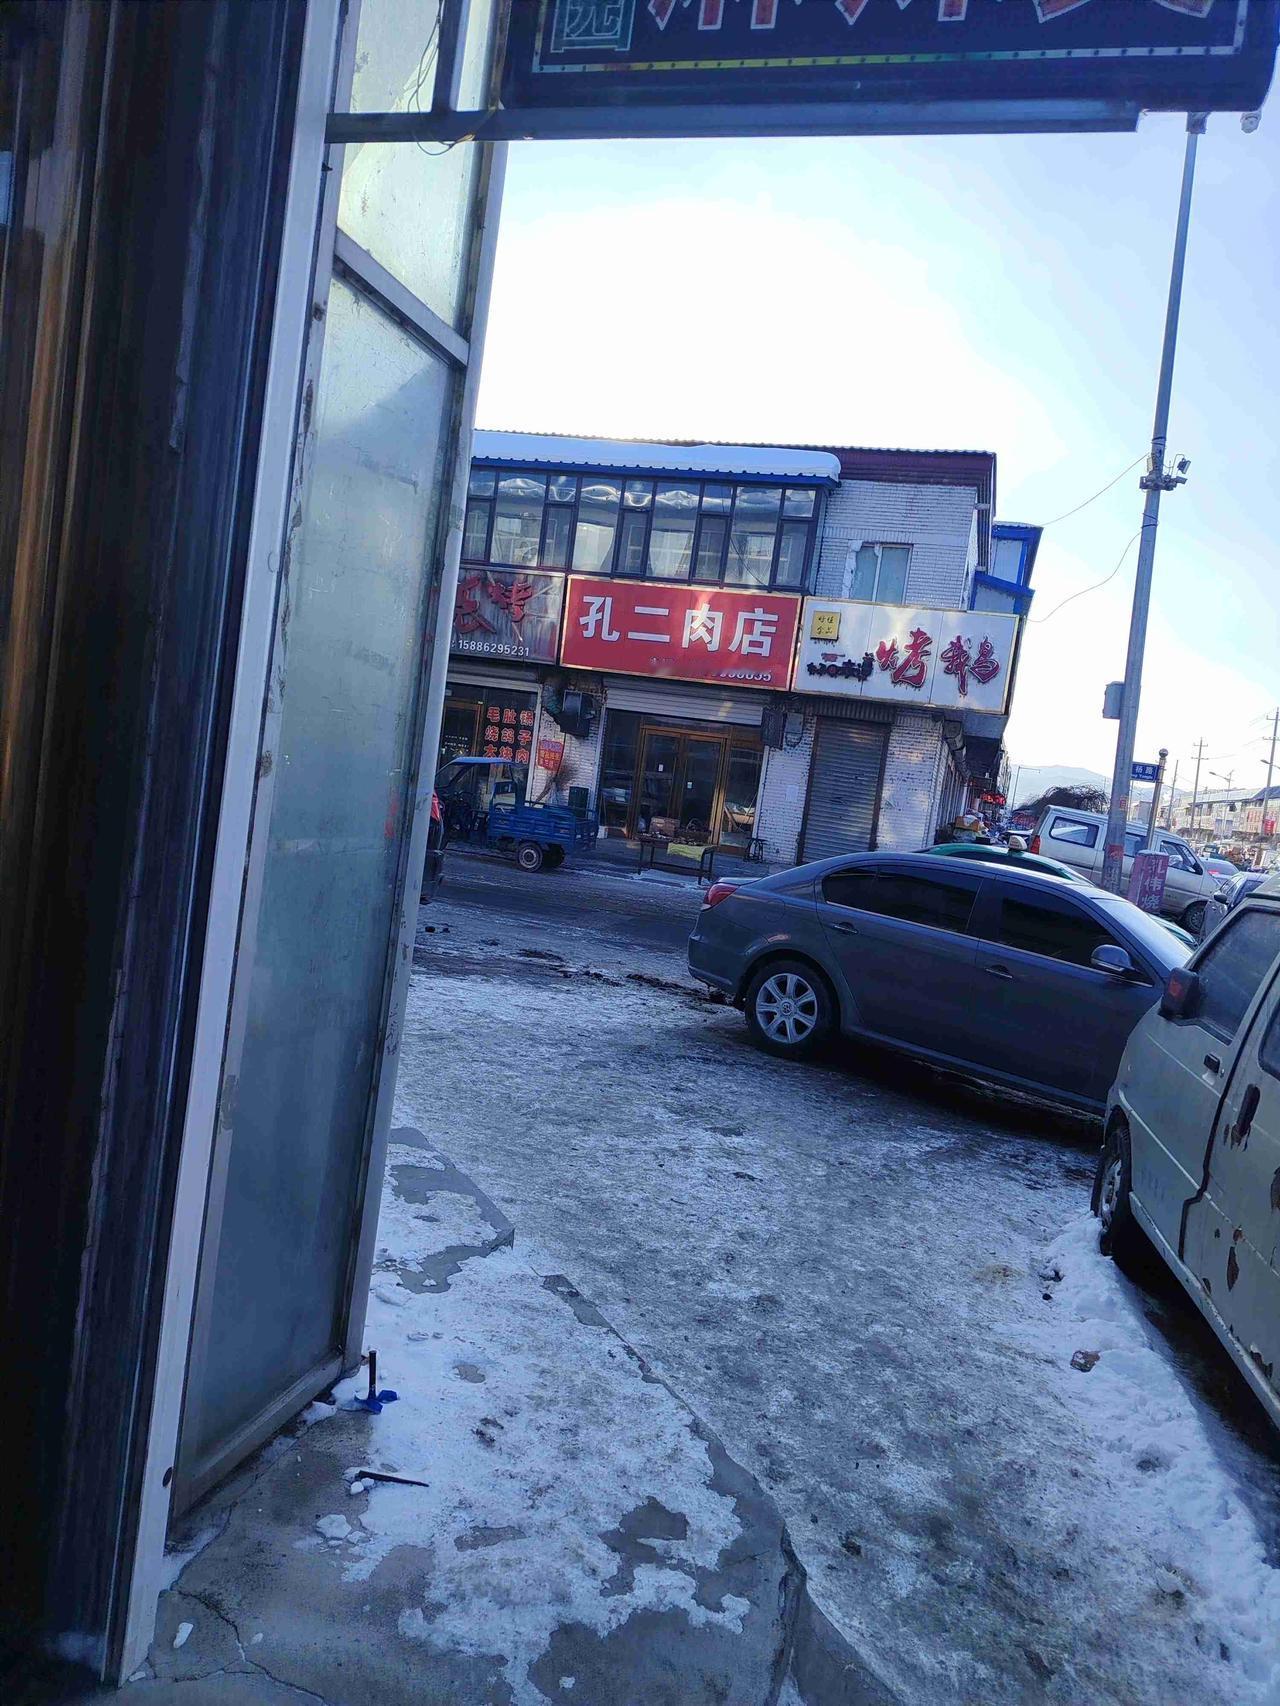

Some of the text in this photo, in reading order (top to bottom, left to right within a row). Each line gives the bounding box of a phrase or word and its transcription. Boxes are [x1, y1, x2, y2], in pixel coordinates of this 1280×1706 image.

[579, 596, 779, 657] 孔二肉店
[457, 639, 530, 657] 15886295231
